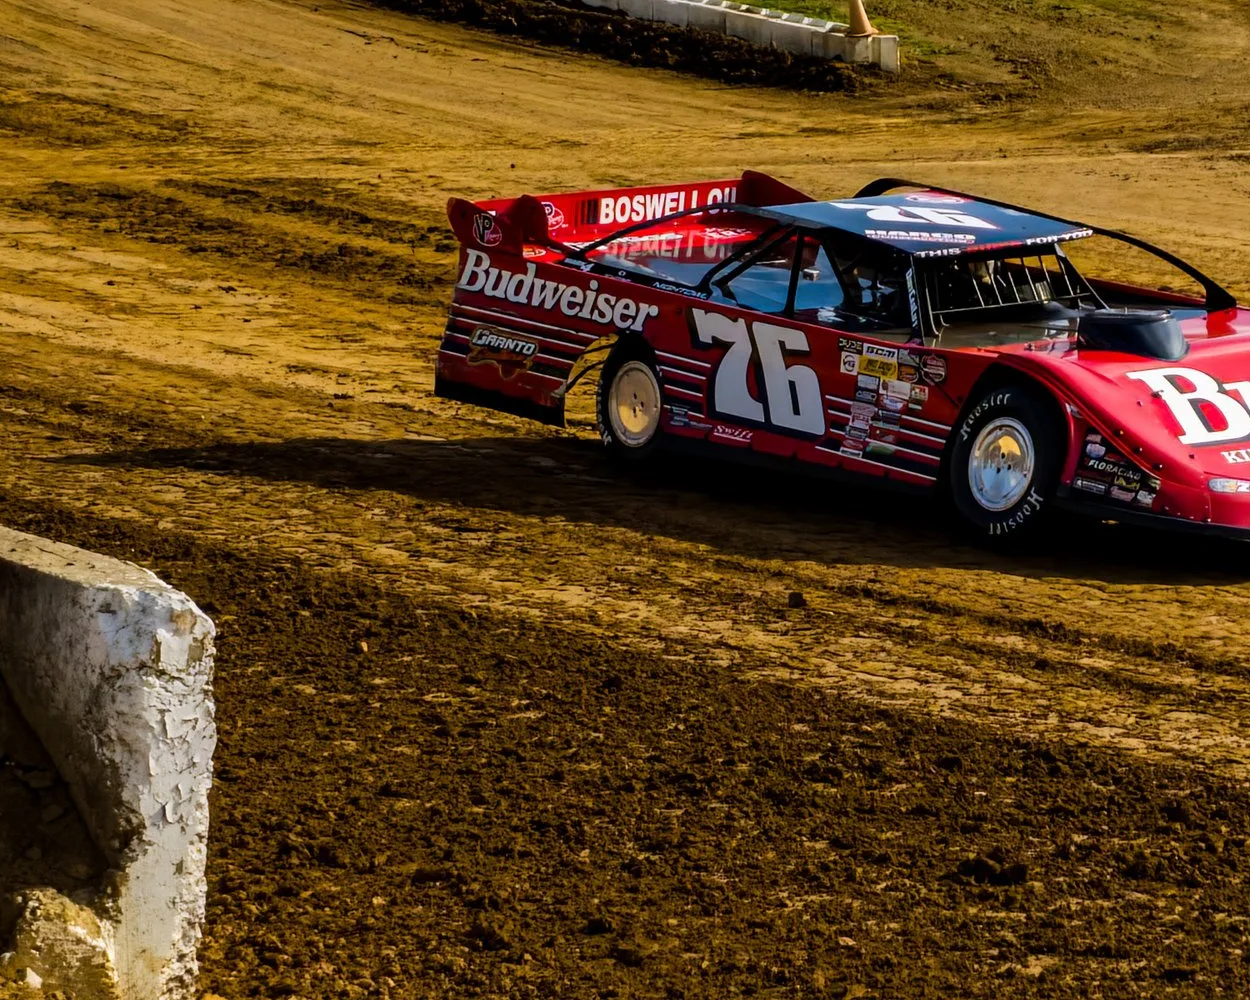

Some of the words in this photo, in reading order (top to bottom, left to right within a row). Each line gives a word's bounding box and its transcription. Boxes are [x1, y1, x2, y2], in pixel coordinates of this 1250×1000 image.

[600, 190, 703, 224] BOSWELL
[915, 247, 962, 258] THIS
[457, 248, 659, 332] Budweiser
[692, 307, 825, 435] 76
